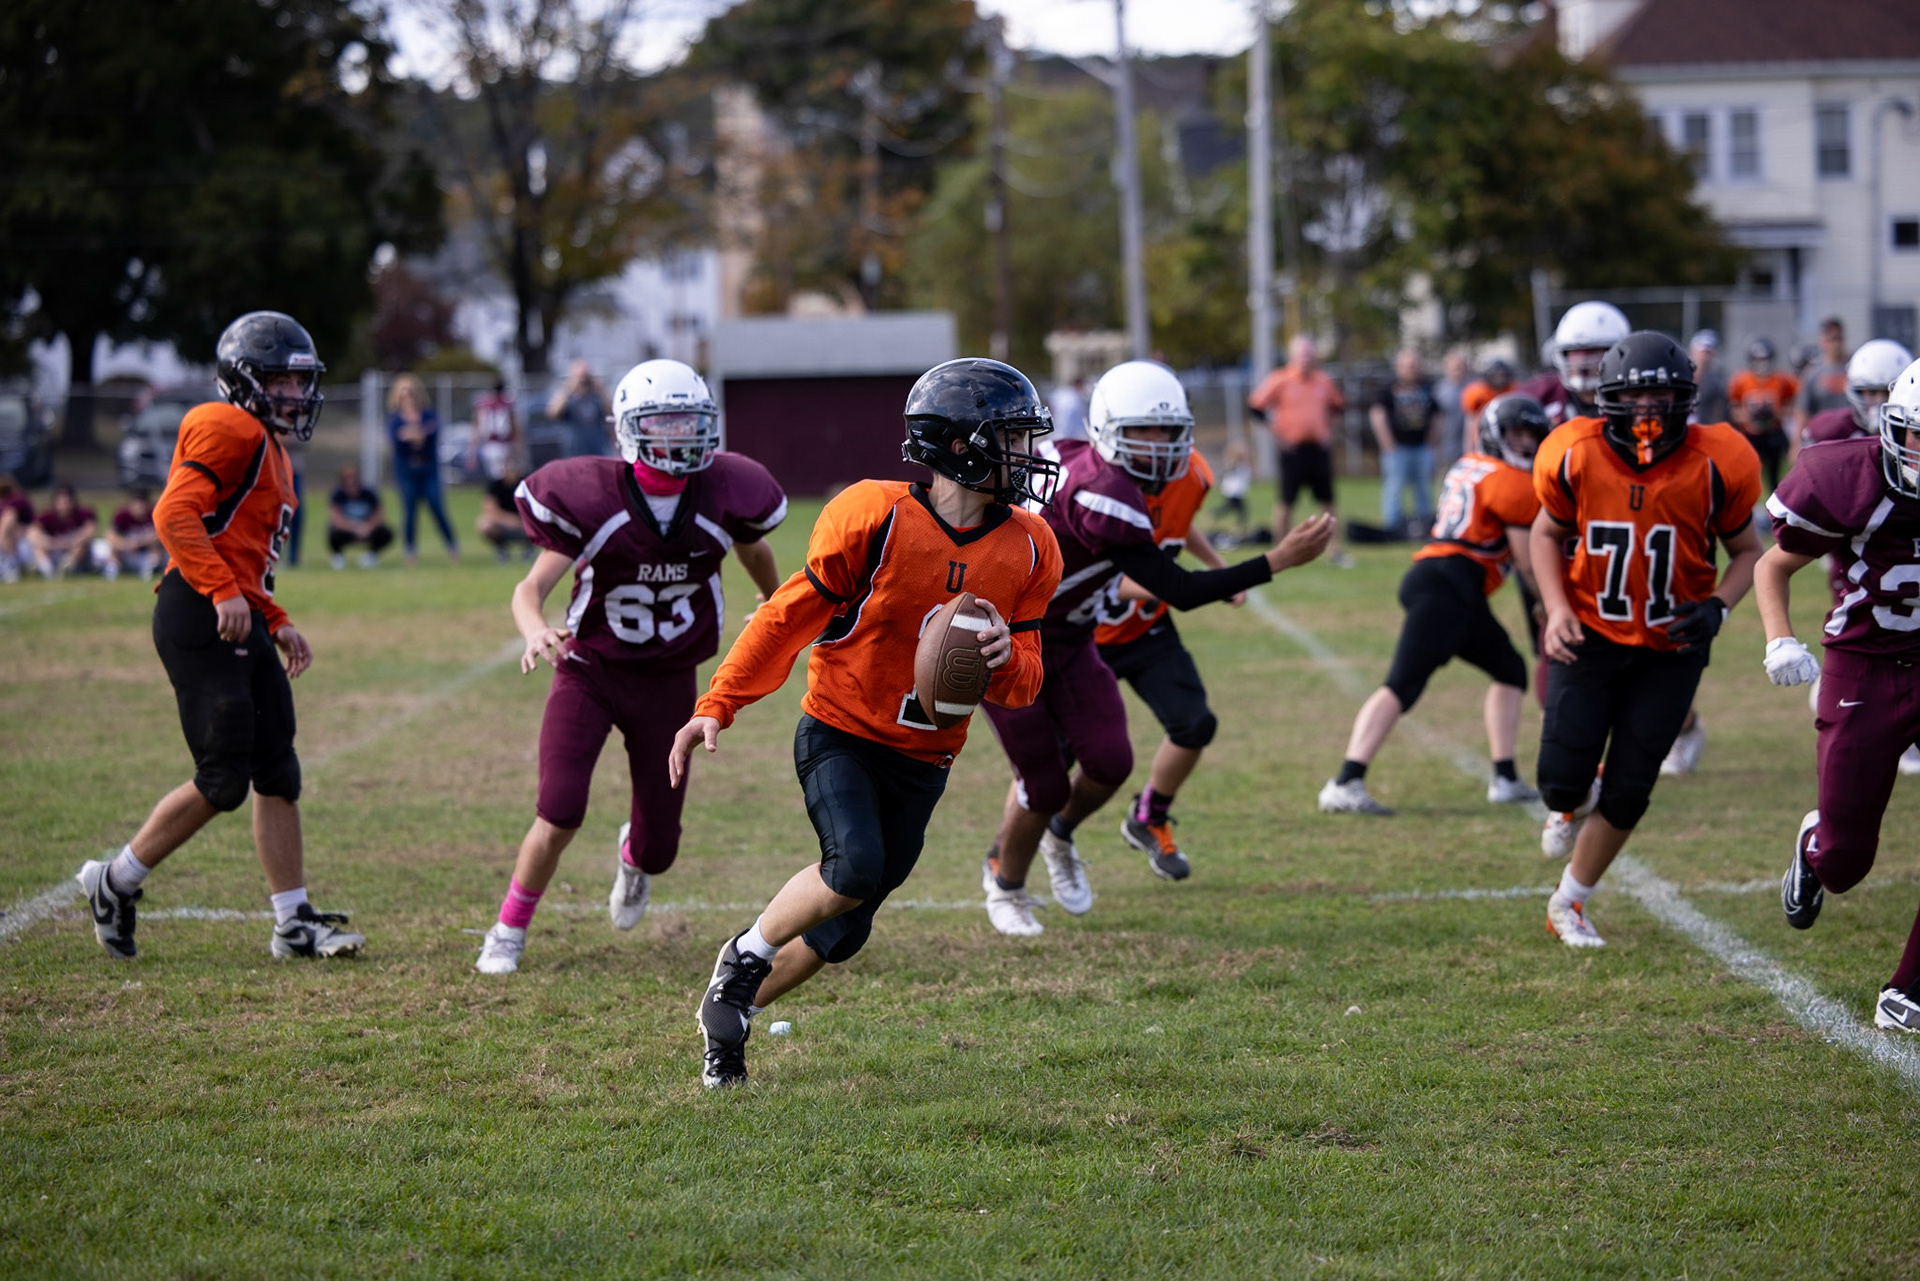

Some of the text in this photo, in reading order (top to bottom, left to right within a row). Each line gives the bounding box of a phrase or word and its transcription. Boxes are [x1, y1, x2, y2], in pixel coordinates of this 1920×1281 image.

[1630, 484, 1645, 511] U
[637, 563, 688, 581] RAMS
[945, 560, 967, 593] U
[1586, 520, 1676, 628] 71
[604, 583, 700, 644] 63
